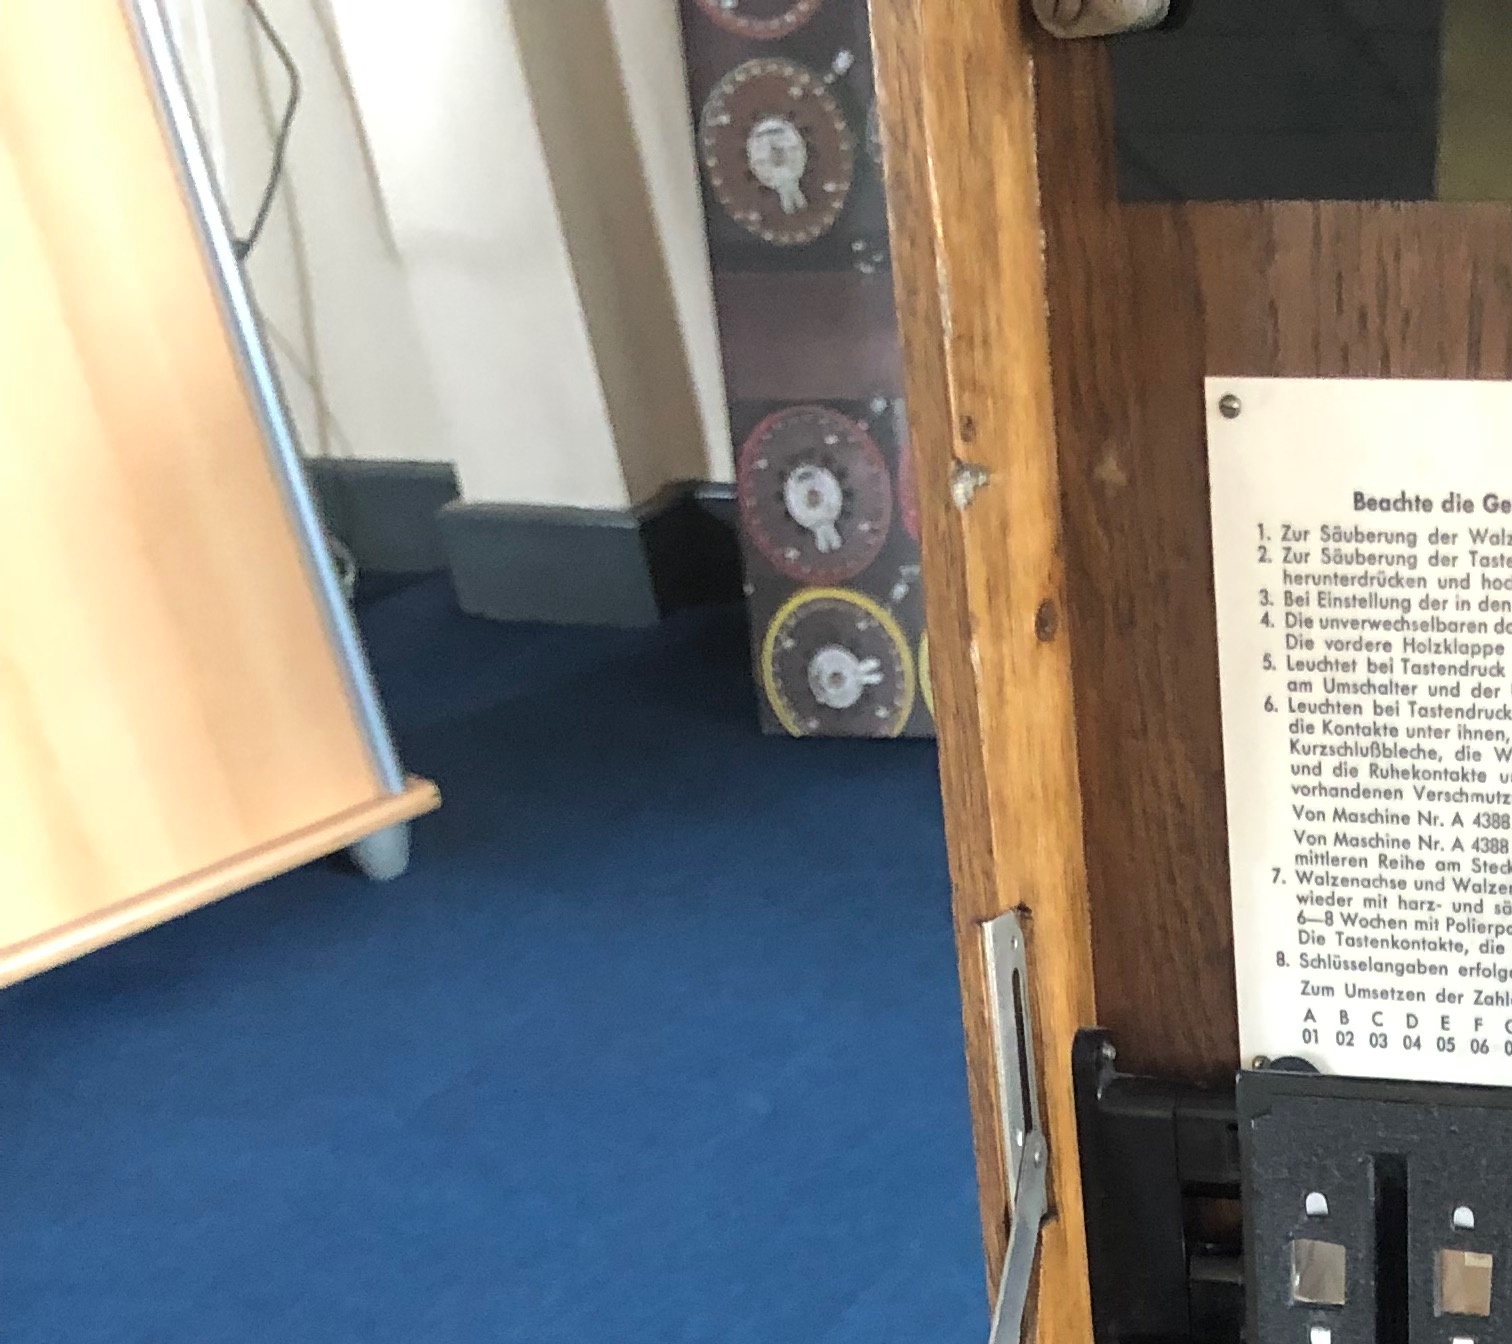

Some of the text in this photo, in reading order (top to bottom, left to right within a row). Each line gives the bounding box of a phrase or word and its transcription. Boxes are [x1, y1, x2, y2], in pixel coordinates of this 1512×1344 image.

[1352, 489, 1433, 513] Beachte
[1440, 490, 1474, 514] die
[1256, 522, 1271, 541] 1.
[1280, 522, 1310, 542] Zur
[1319, 523, 1417, 547] Säuberung
[1427, 526, 1458, 545] der
[1282, 567, 1427, 589] herunterdrücken
[1437, 572, 1471, 590] und
[1285, 679, 1313, 693] am
[1322, 676, 1417, 696] Umschalter
[1427, 680, 1461, 698] und
[1469, 681, 1501, 699] der
[1290, 780, 1404, 800] vorhandenen
[1291, 803, 1326, 822] Von
[1331, 806, 1411, 826] Maschine
[1416, 809, 1444, 827] Nr.
[1450, 810, 1464, 828] A
[1471, 811, 1511, 830] 4388
[1275, 949, 1290, 967] 8.
[1298, 951, 1449, 977] Schlüsselangaben
[1299, 979, 1335, 997] Zum
[1343, 982, 1426, 1002] Umsetzen
[1434, 986, 1464, 1004] der
